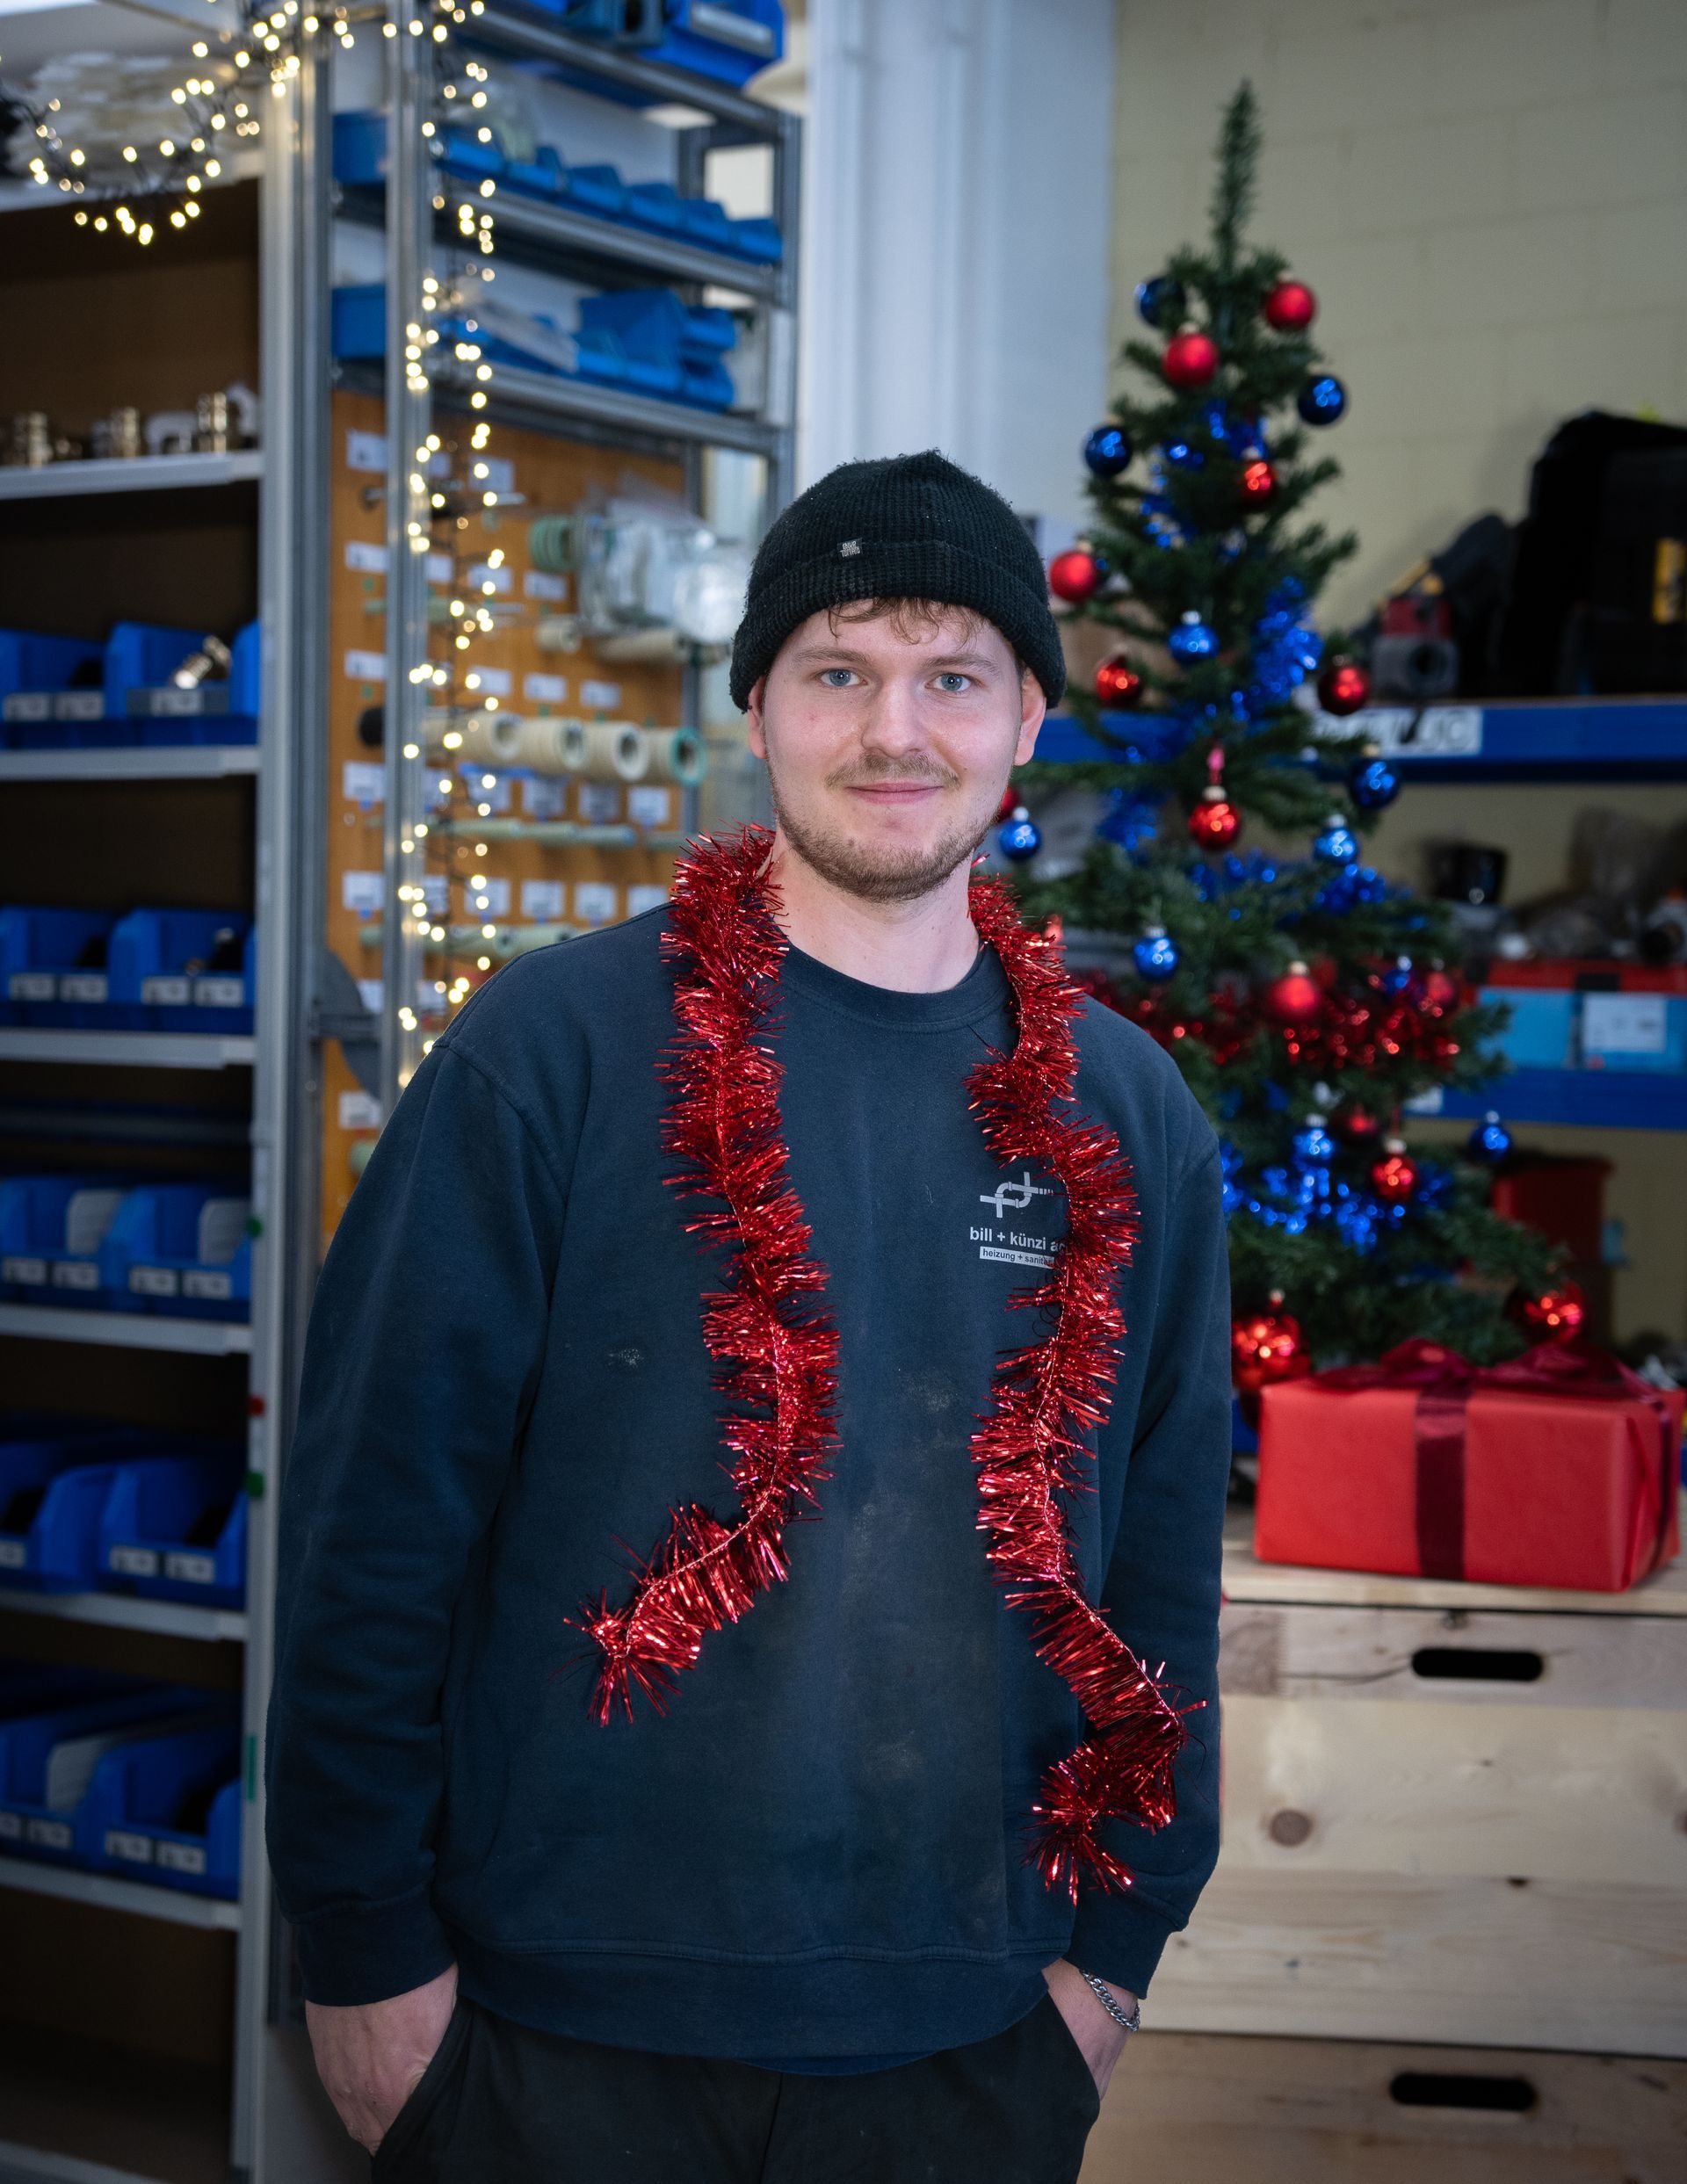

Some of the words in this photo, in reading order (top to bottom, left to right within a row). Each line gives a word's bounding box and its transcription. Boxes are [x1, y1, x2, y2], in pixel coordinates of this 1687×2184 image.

[969, 1226, 993, 1242] bill
[996, 1232, 1006, 1242] +
[1010, 1232, 1046, 1250] künzi
[982, 1248, 1016, 1262] heizung
